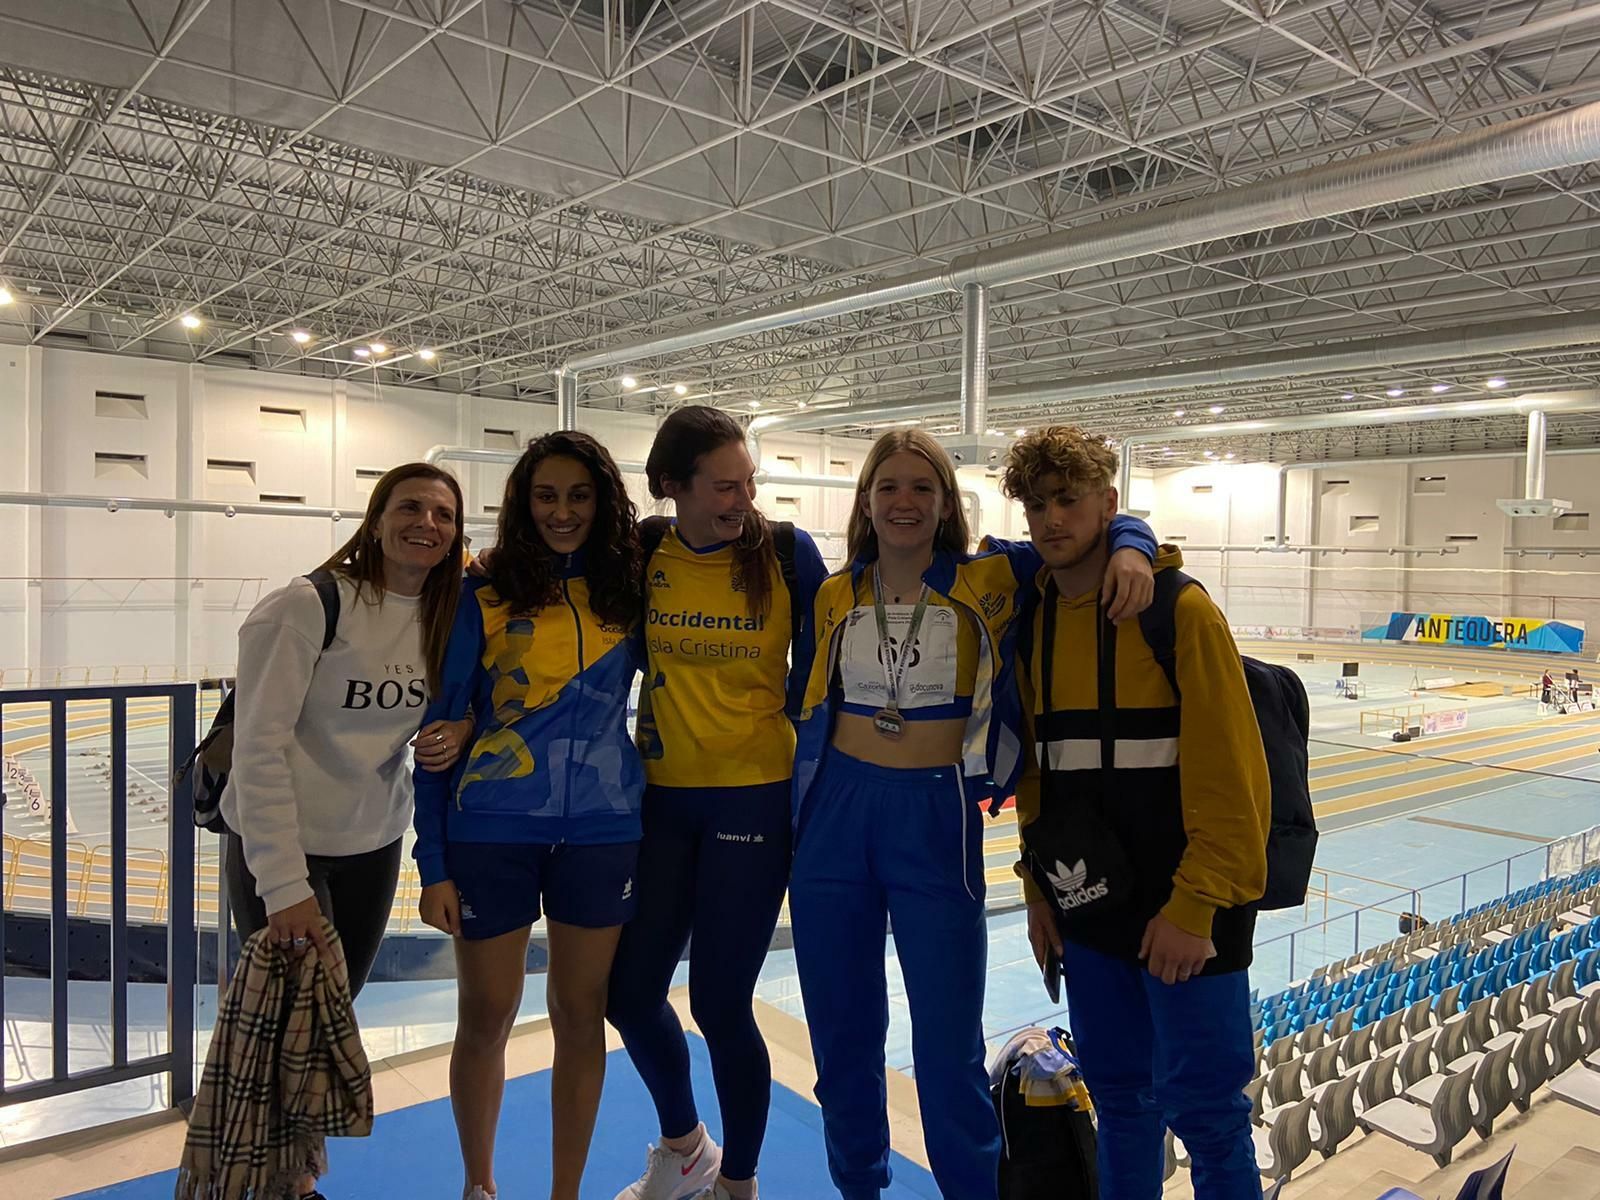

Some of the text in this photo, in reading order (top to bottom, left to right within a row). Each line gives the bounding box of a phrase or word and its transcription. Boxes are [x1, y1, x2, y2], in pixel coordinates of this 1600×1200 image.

[648, 609, 765, 632] Occidental
[1414, 617, 1528, 645] ANTEQUERA
[647, 636, 761, 660] sla Cristina
[384, 664, 415, 675] YES
[341, 678, 432, 710] BOS
[10, 767, 18, 780] 2
[31, 798, 40, 811] 6
[1057, 883, 1109, 910] adidas
